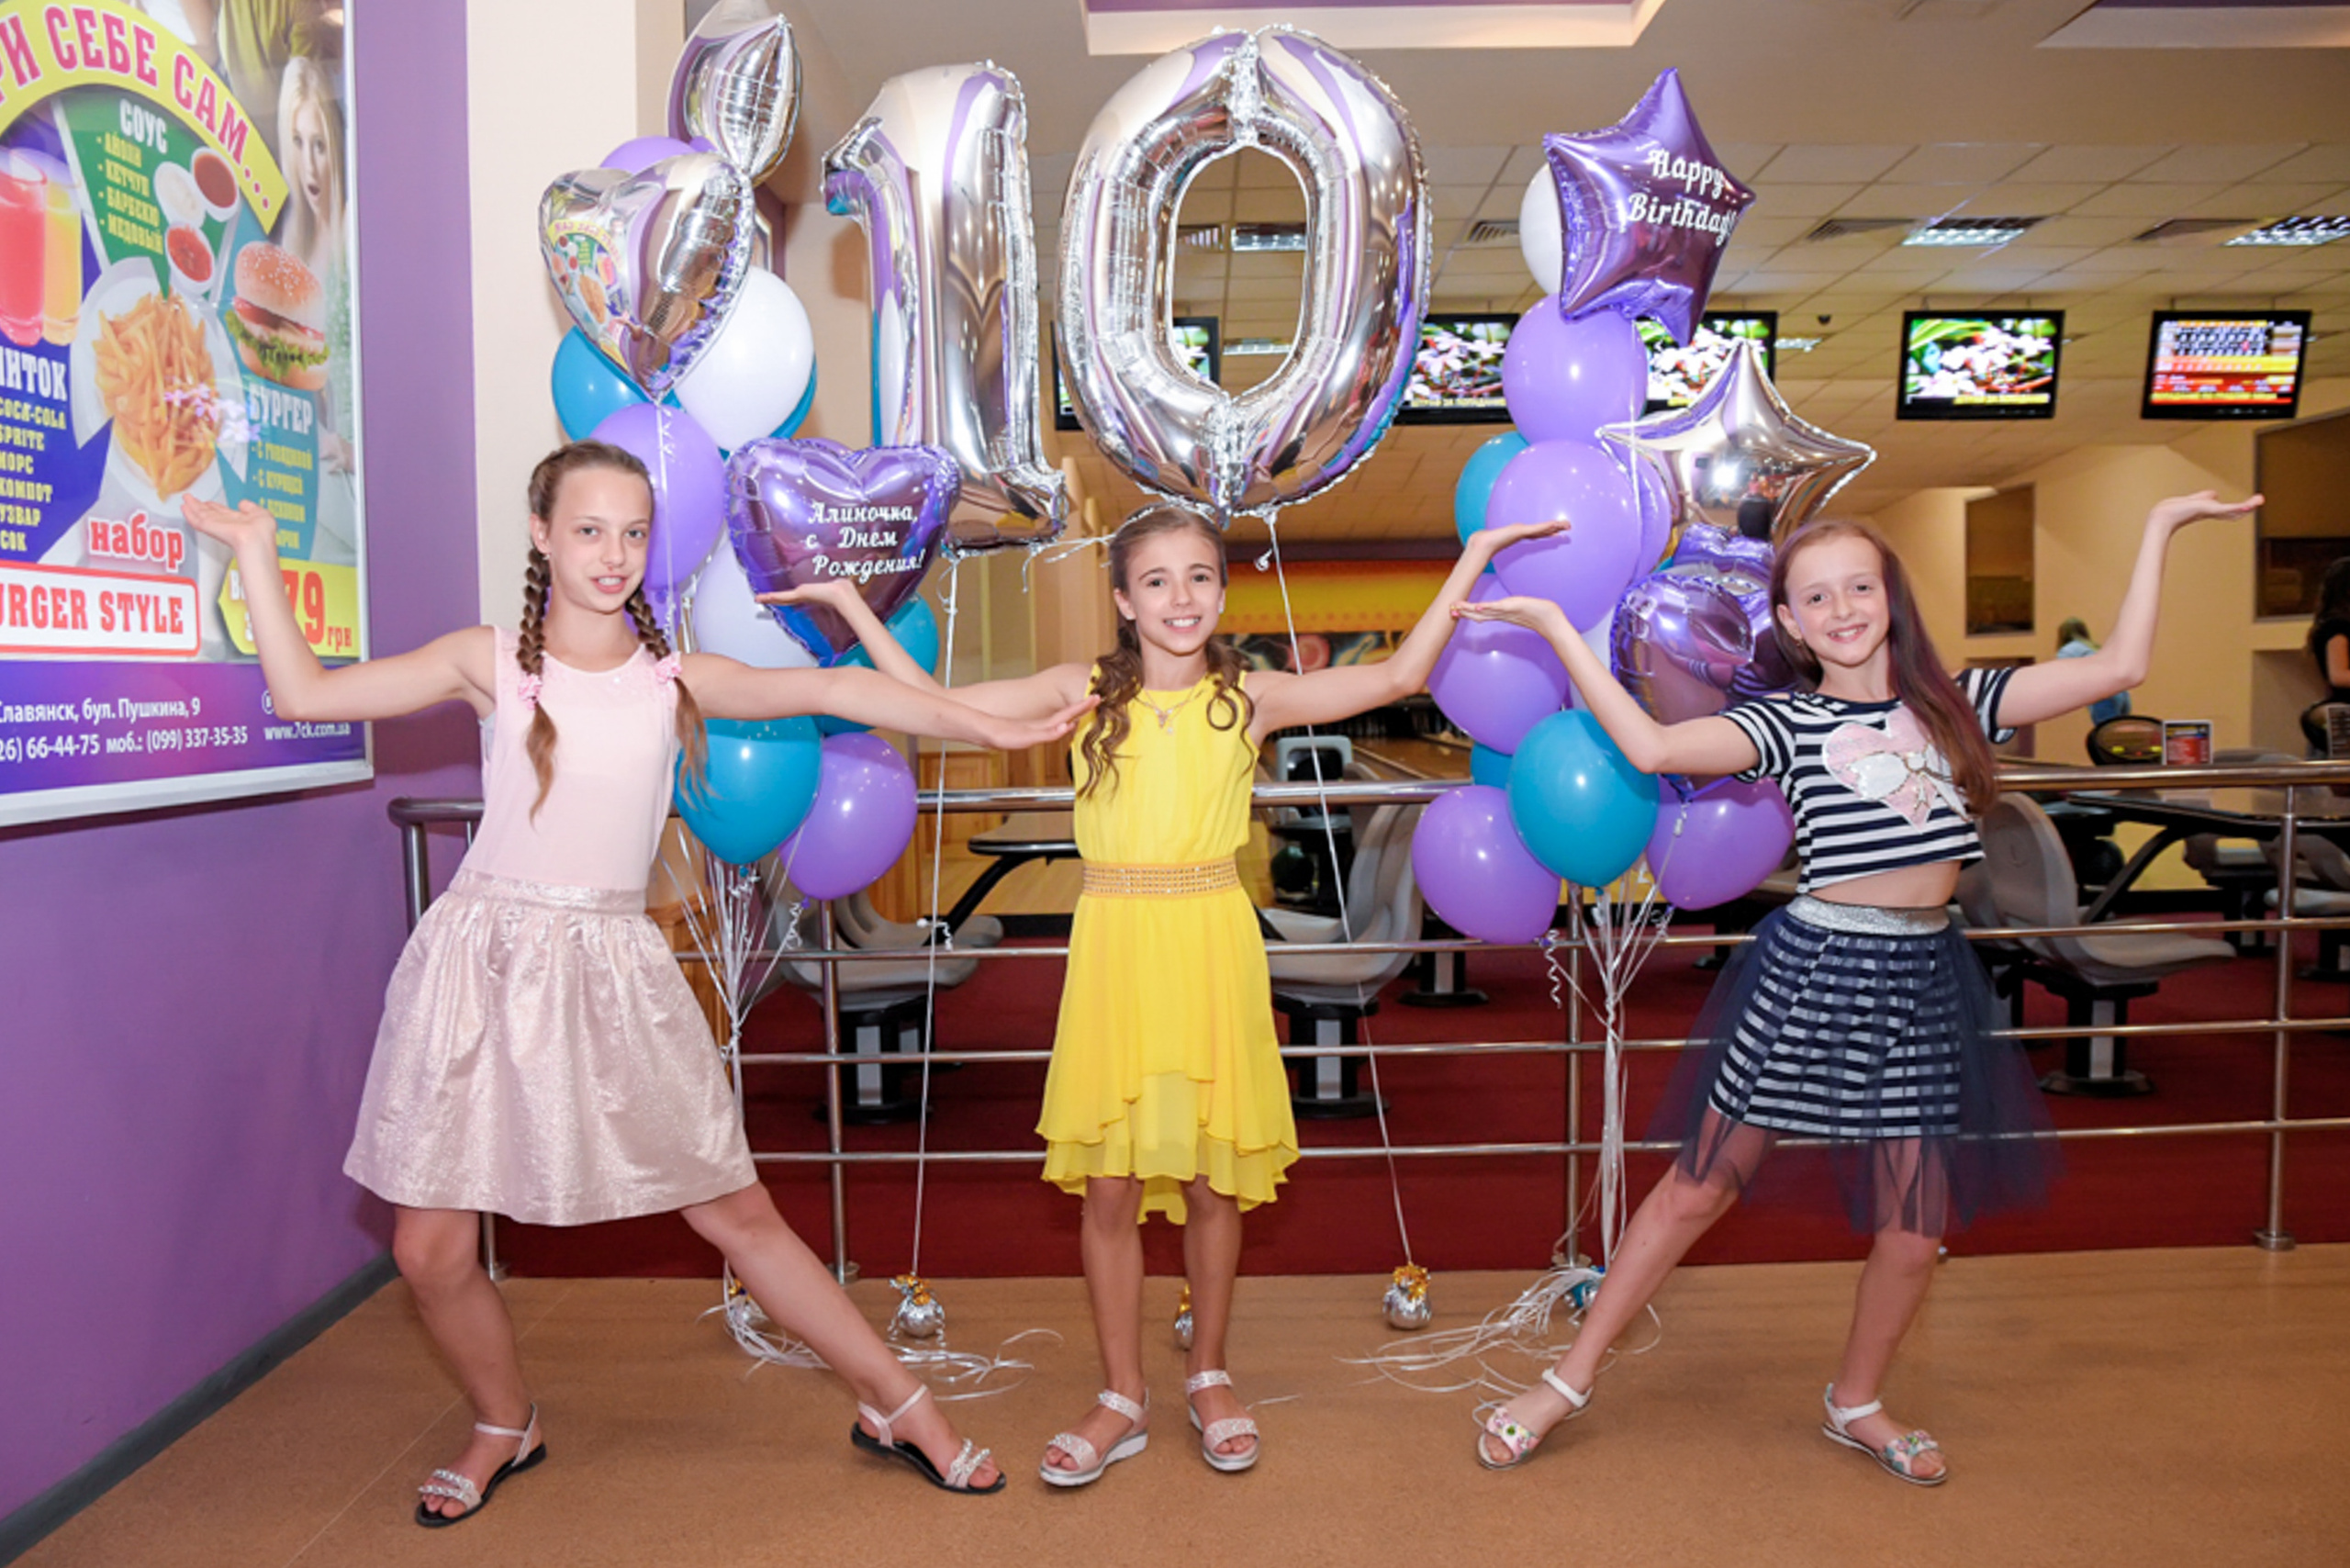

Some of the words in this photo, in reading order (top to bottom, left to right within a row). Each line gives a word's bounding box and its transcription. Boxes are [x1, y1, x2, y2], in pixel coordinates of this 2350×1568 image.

[44, 6, 158, 88] СЕБЕ
[173, 53, 270, 209] САМ...
[119, 98, 167, 154] СОУС
[106, 158, 150, 197] КЕТЧУП
[1647, 148, 1724, 199] Happy
[106, 185, 160, 228] БАРБЕКЮ
[107, 212, 163, 255] МЕДОВЫЙ
[248, 382, 314, 435] БУРГЕР
[0, 477, 53, 503] КОМПОТ
[808, 500, 918, 524] Алиночка,
[0, 529, 28, 552] СОК
[90, 512, 184, 571] набор
[806, 533, 819, 550] с
[837, 526, 898, 548] Днем
[811, 548, 926, 585] Рождения!
[0, 582, 89, 632] RGER
[99, 590, 184, 635] STYLE
[82, 697, 116, 725] бул.
[118, 698, 189, 724] Пушкина,
[191, 696, 201, 716] 9
[27, 734, 101, 759] 66-44-75
[106, 731, 143, 754] моб.:
[147, 728, 184, 754] (099)
[185, 725, 249, 749] 337-35-35
